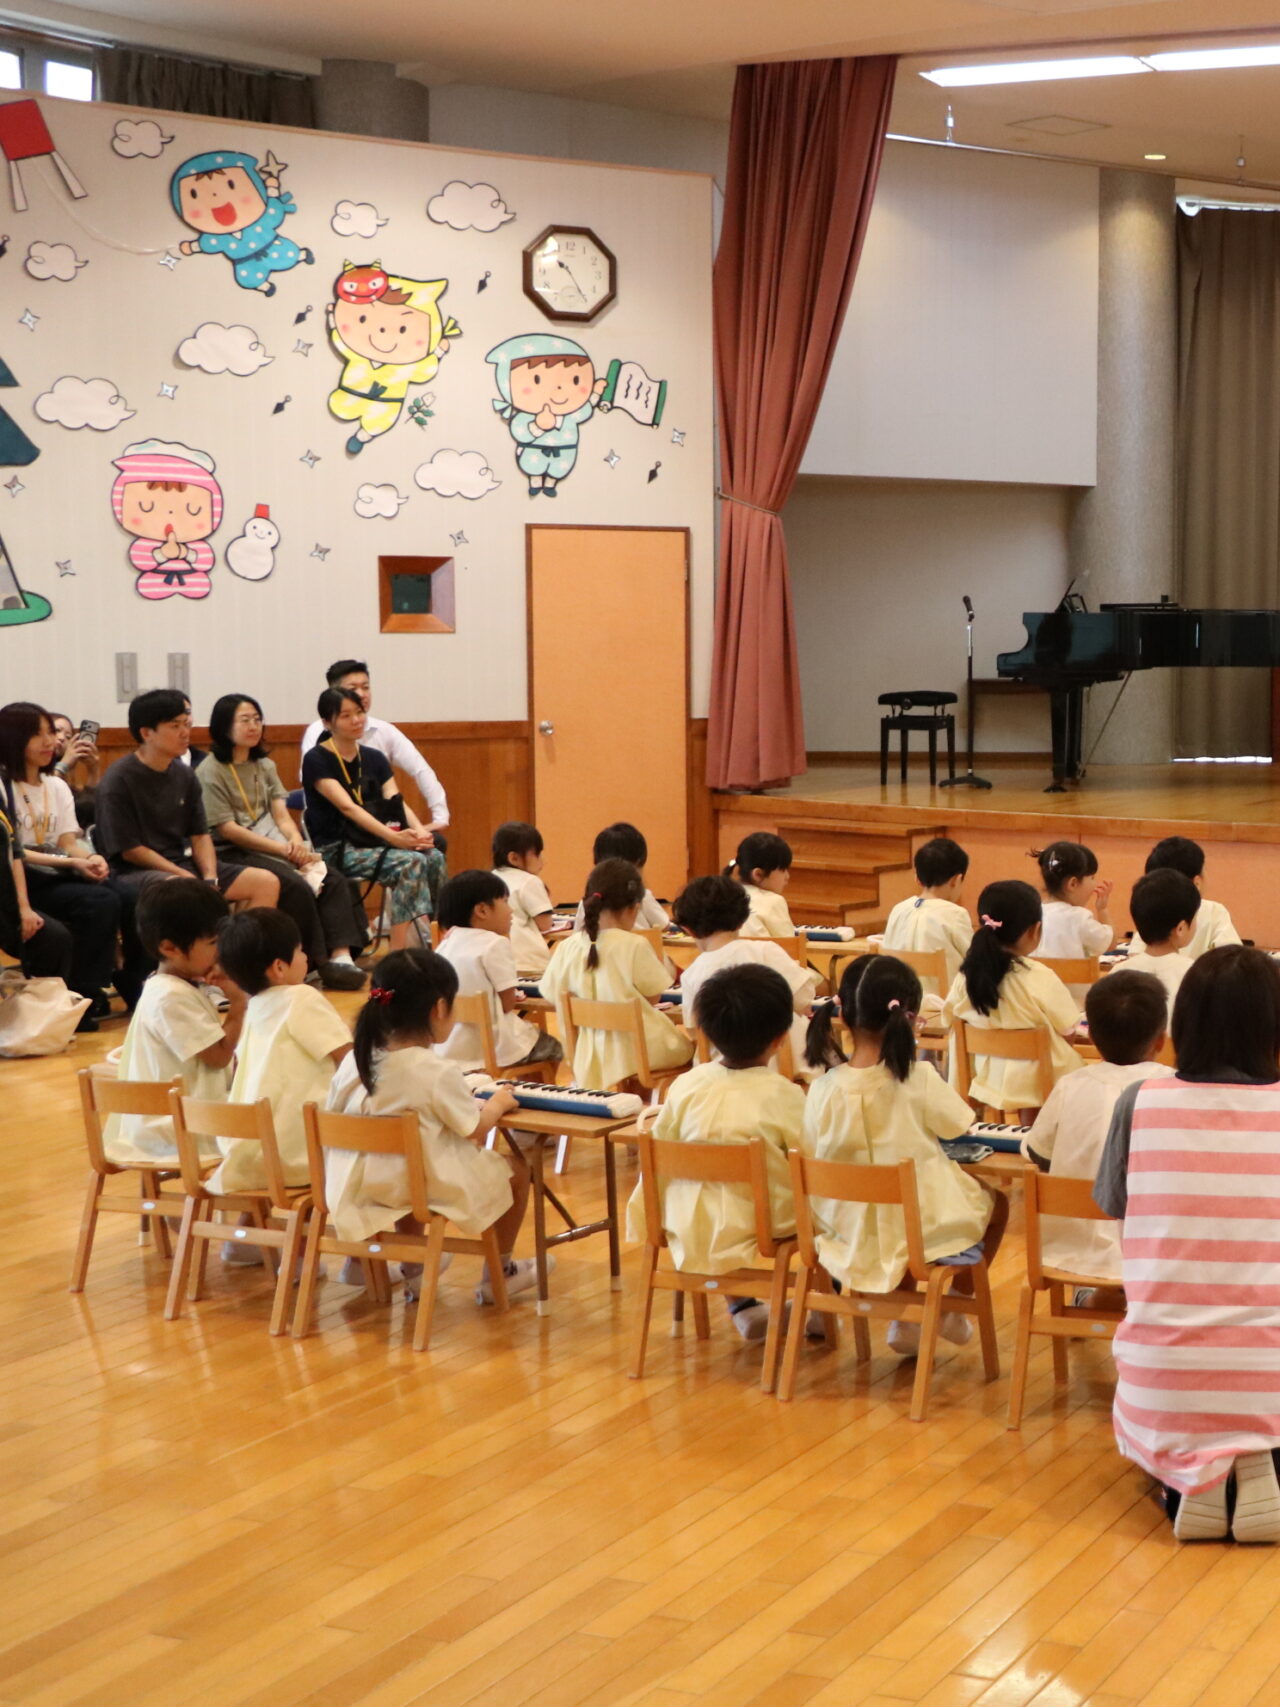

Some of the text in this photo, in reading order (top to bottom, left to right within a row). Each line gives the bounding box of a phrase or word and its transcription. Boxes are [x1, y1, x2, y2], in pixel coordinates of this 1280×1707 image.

[565, 240, 576, 251] 12
[590, 256, 598, 266] 2
[594, 270, 602, 280] 3
